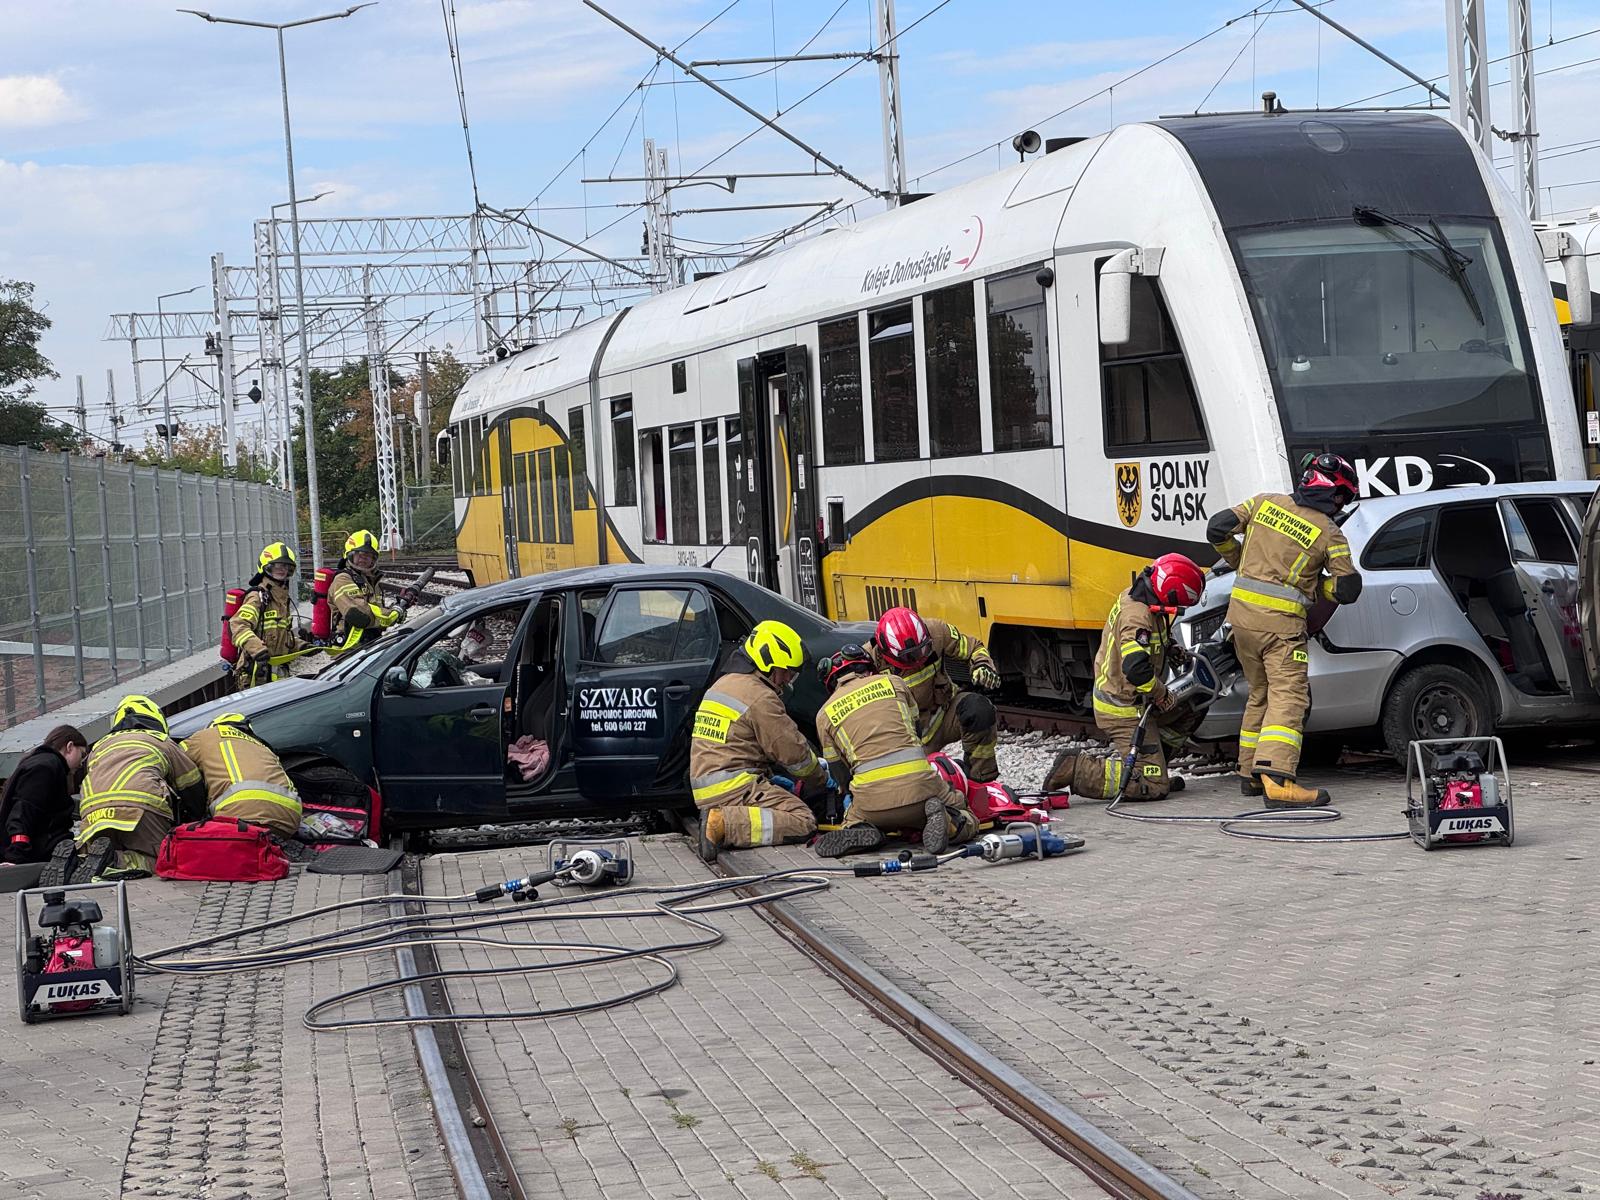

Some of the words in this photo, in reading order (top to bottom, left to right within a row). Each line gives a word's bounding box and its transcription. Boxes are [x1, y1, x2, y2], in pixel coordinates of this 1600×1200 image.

[860, 264, 890, 295] Koleje
[1149, 460, 1210, 490] DOLNY
[1354, 455, 1434, 498] KD
[1151, 488, 1209, 526] ŚLĄSK
[579, 687, 657, 708] SZWARC
[580, 709, 622, 719] AUTO-POMOC
[623, 708, 658, 719] DROGOWA
[591, 721, 603, 732] tel.
[604, 721, 618, 731] 600
[633, 721, 647, 731] 227
[1145, 767, 1160, 775] PSP
[1448, 818, 1493, 831] LUKAS
[47, 982, 101, 999] LUKAS
